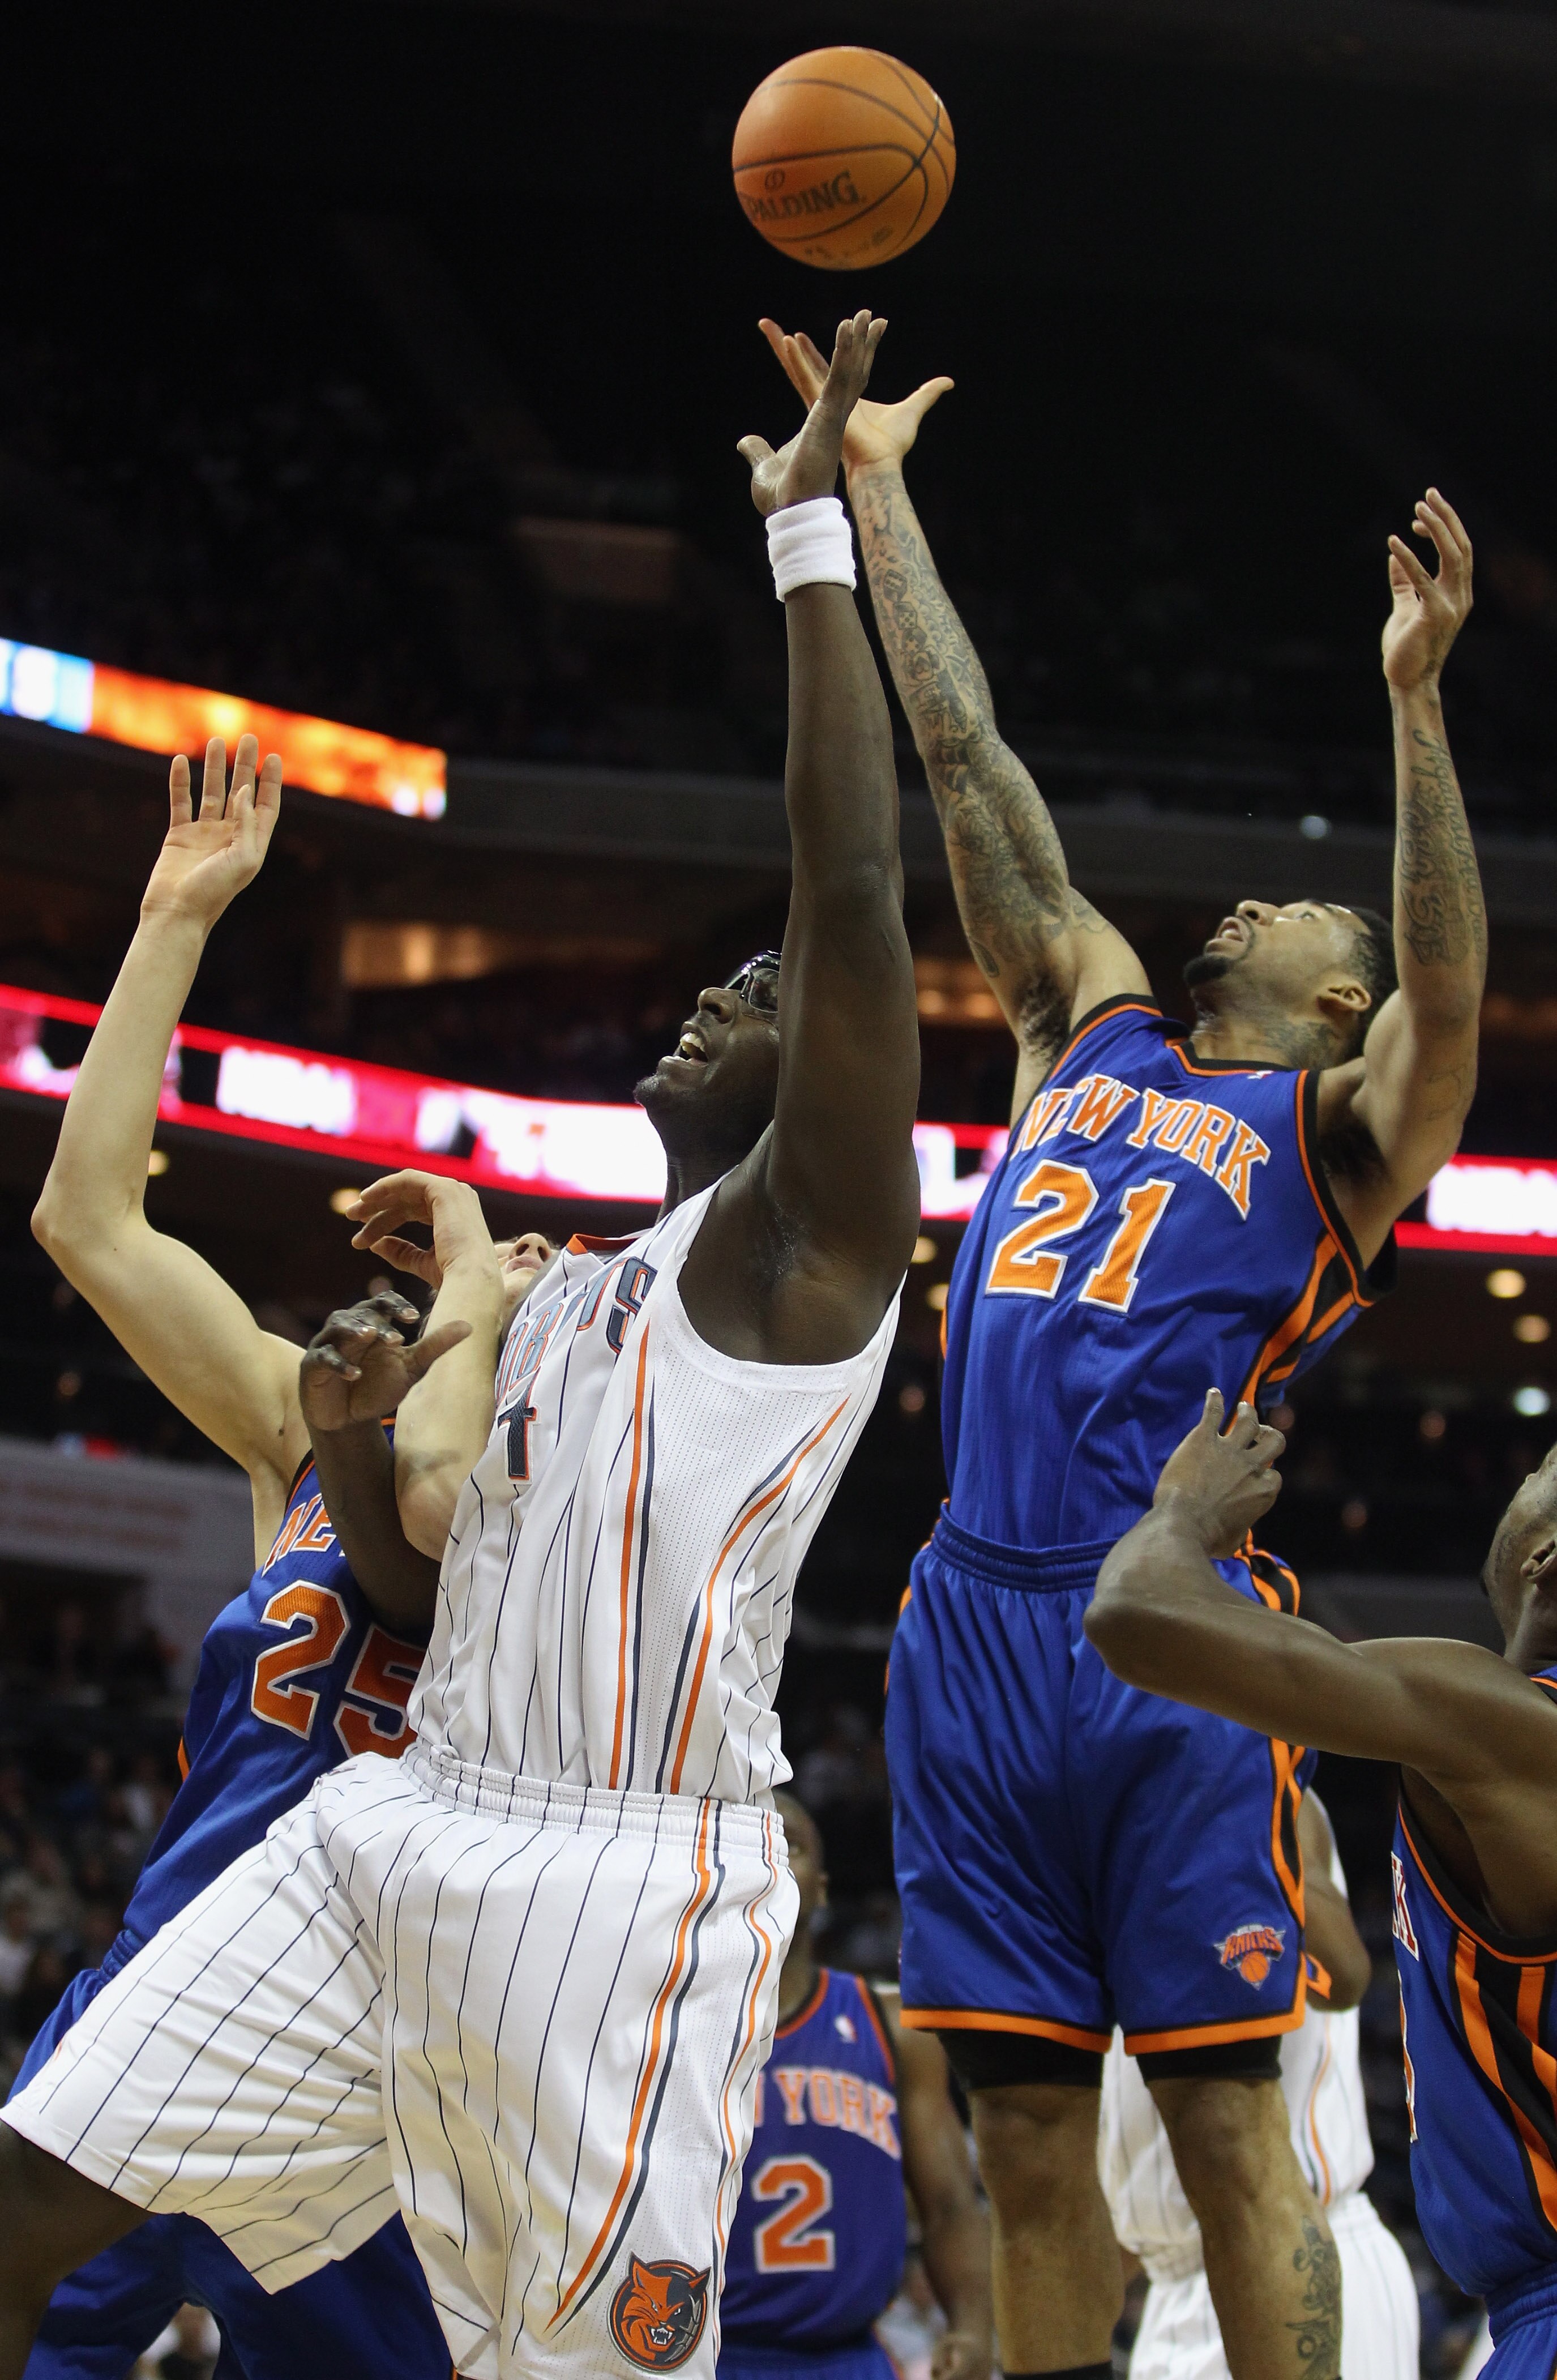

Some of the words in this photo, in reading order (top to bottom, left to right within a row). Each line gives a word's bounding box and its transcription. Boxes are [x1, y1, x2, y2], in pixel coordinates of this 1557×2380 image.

[1009, 1073, 1140, 1161] NEW
[1126, 1087, 1271, 1221] YORK
[985, 1159, 1177, 1313] 21
[260, 1493, 345, 1578] NE
[251, 1579, 428, 1760] 25
[1221, 1926, 1285, 1966] KNICKS
[772, 2067, 902, 2160] YORK
[751, 2154, 836, 2274] 2
